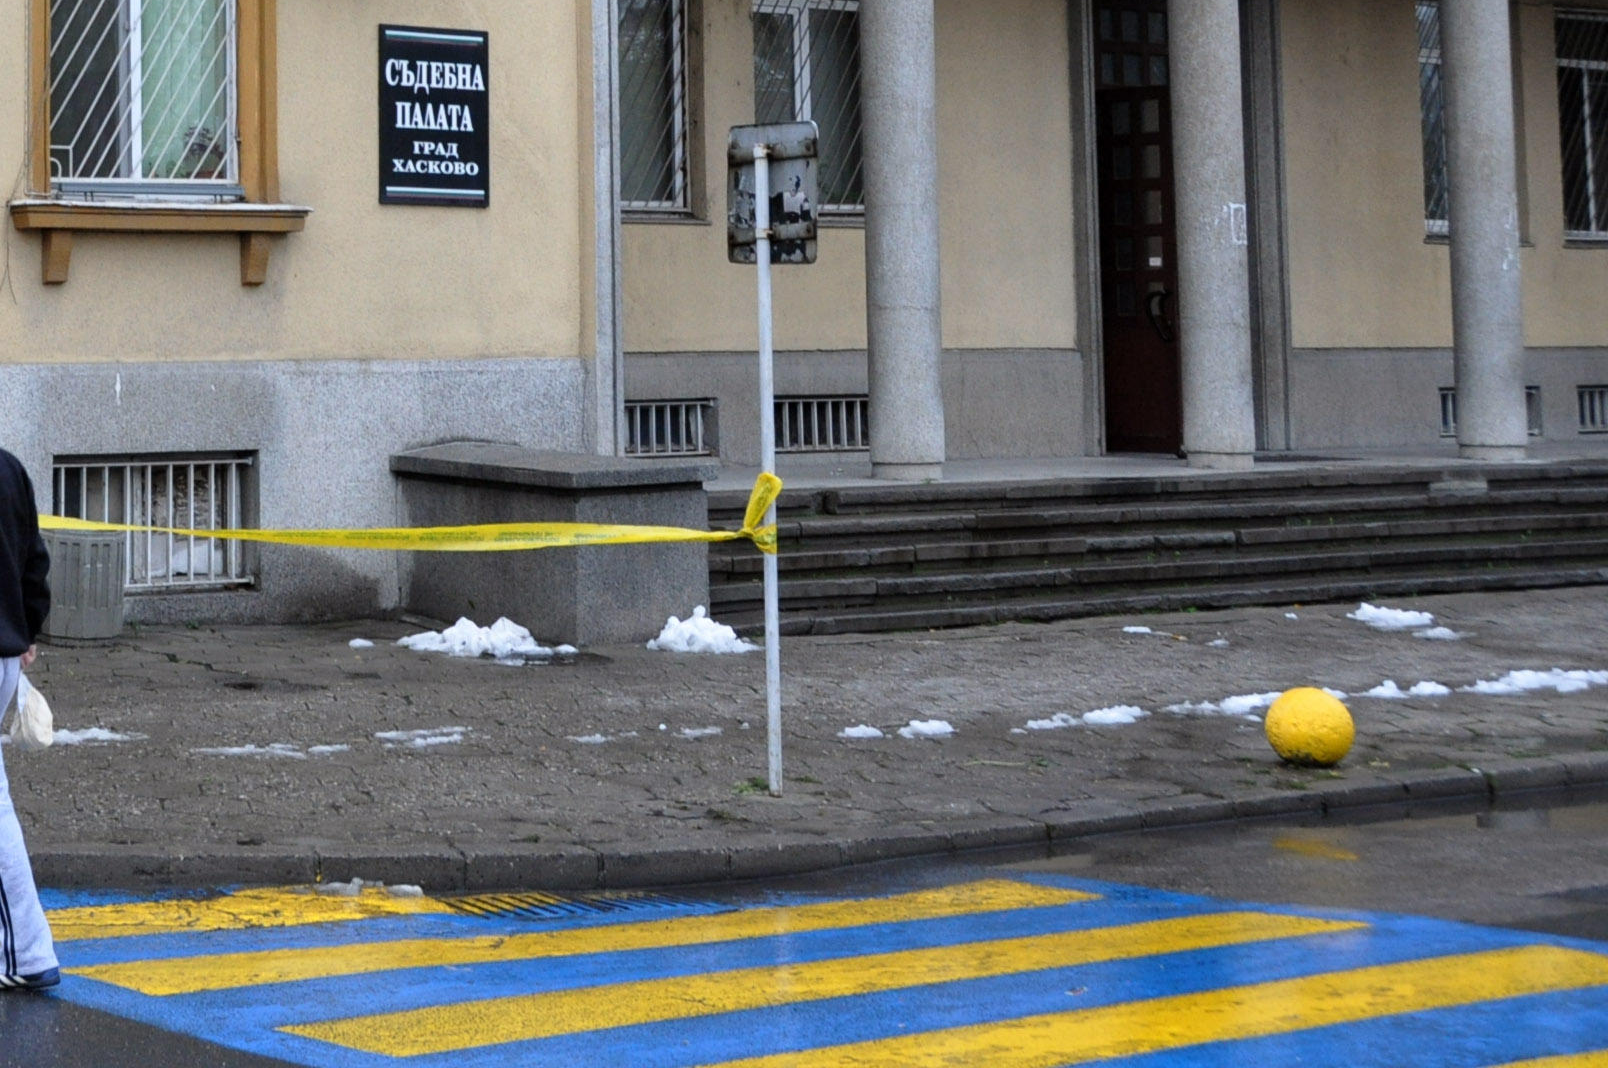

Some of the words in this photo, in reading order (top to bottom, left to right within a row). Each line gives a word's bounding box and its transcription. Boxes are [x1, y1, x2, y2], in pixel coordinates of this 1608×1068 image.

[385, 58, 486, 95] СЪДЕБНА
[395, 101, 474, 132] ПАЛАТА
[413, 140, 459, 159] ГРАД
[392, 158, 480, 175] ХАСКОВО
